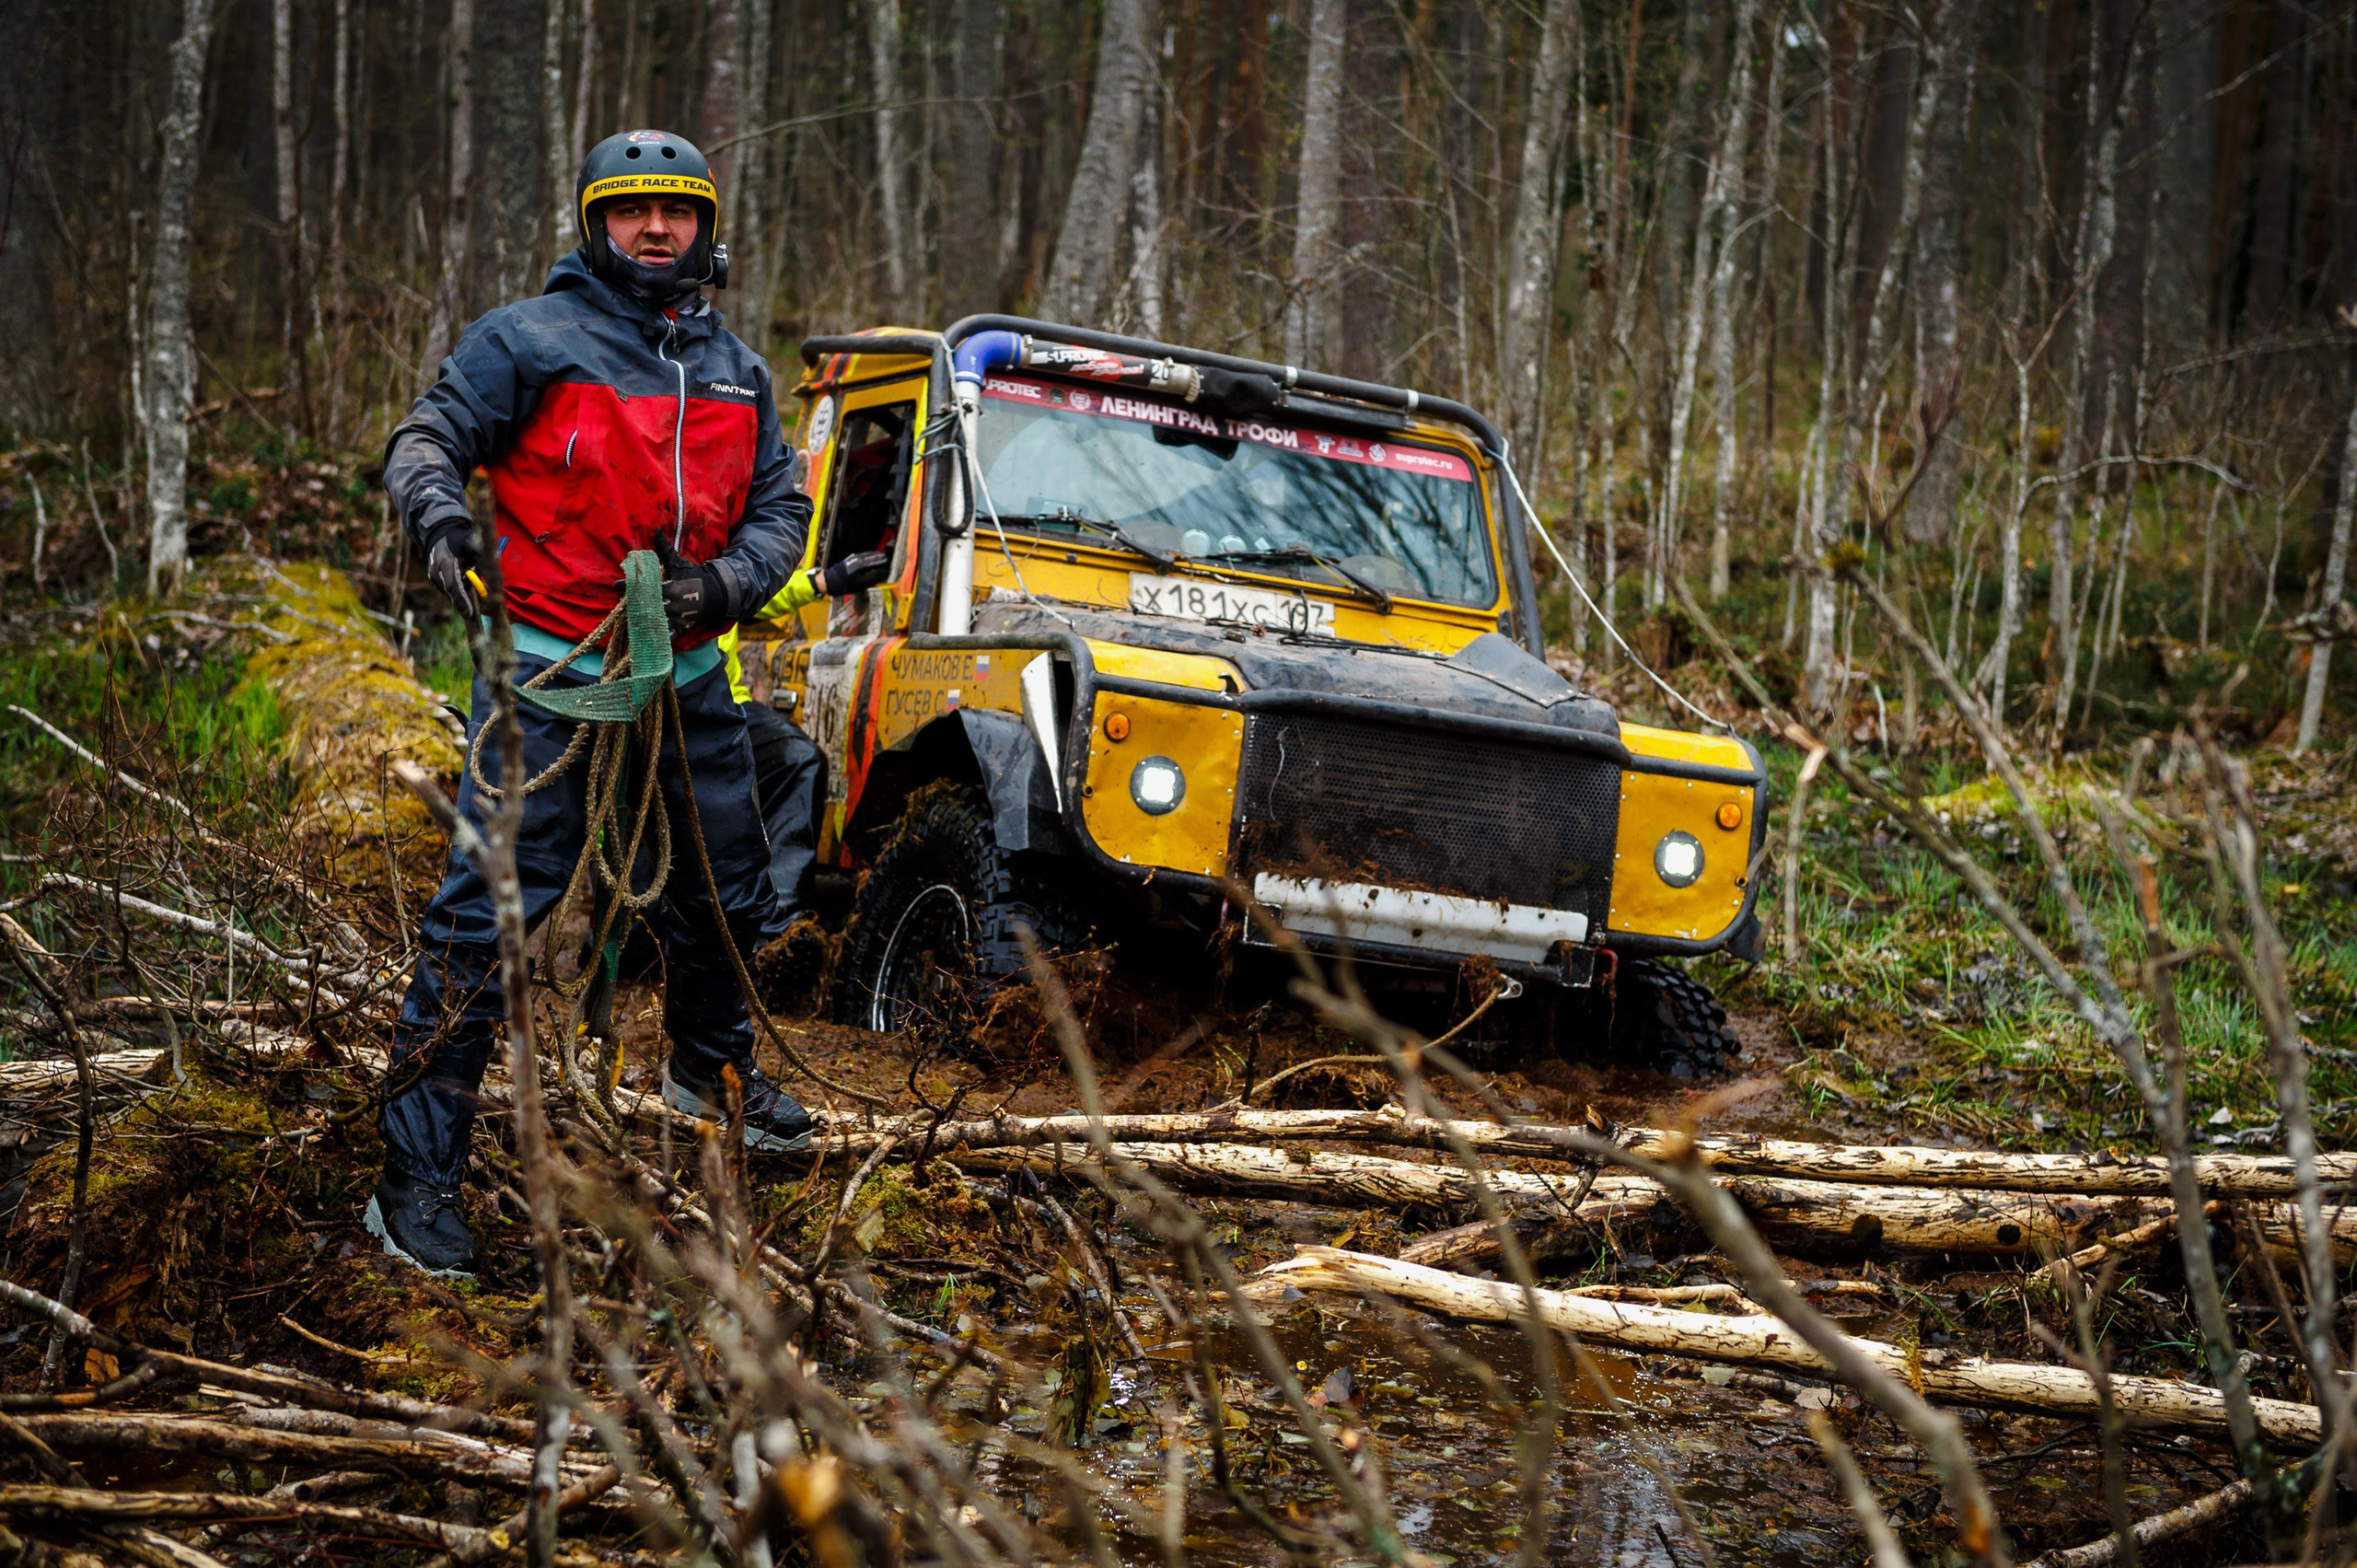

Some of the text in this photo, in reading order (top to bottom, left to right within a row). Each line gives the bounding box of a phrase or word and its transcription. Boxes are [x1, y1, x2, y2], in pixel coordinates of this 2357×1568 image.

[592, 179, 711, 194] BRIDGE RACE TEAM
[982, 378, 1041, 399] PROTEC
[1100, 396, 1298, 448] ЛЕНИНГРАД ТРОФИ
[891, 654, 959, 681] ЧУМАКОВ
[886, 689, 932, 716] ГУСЕВ
